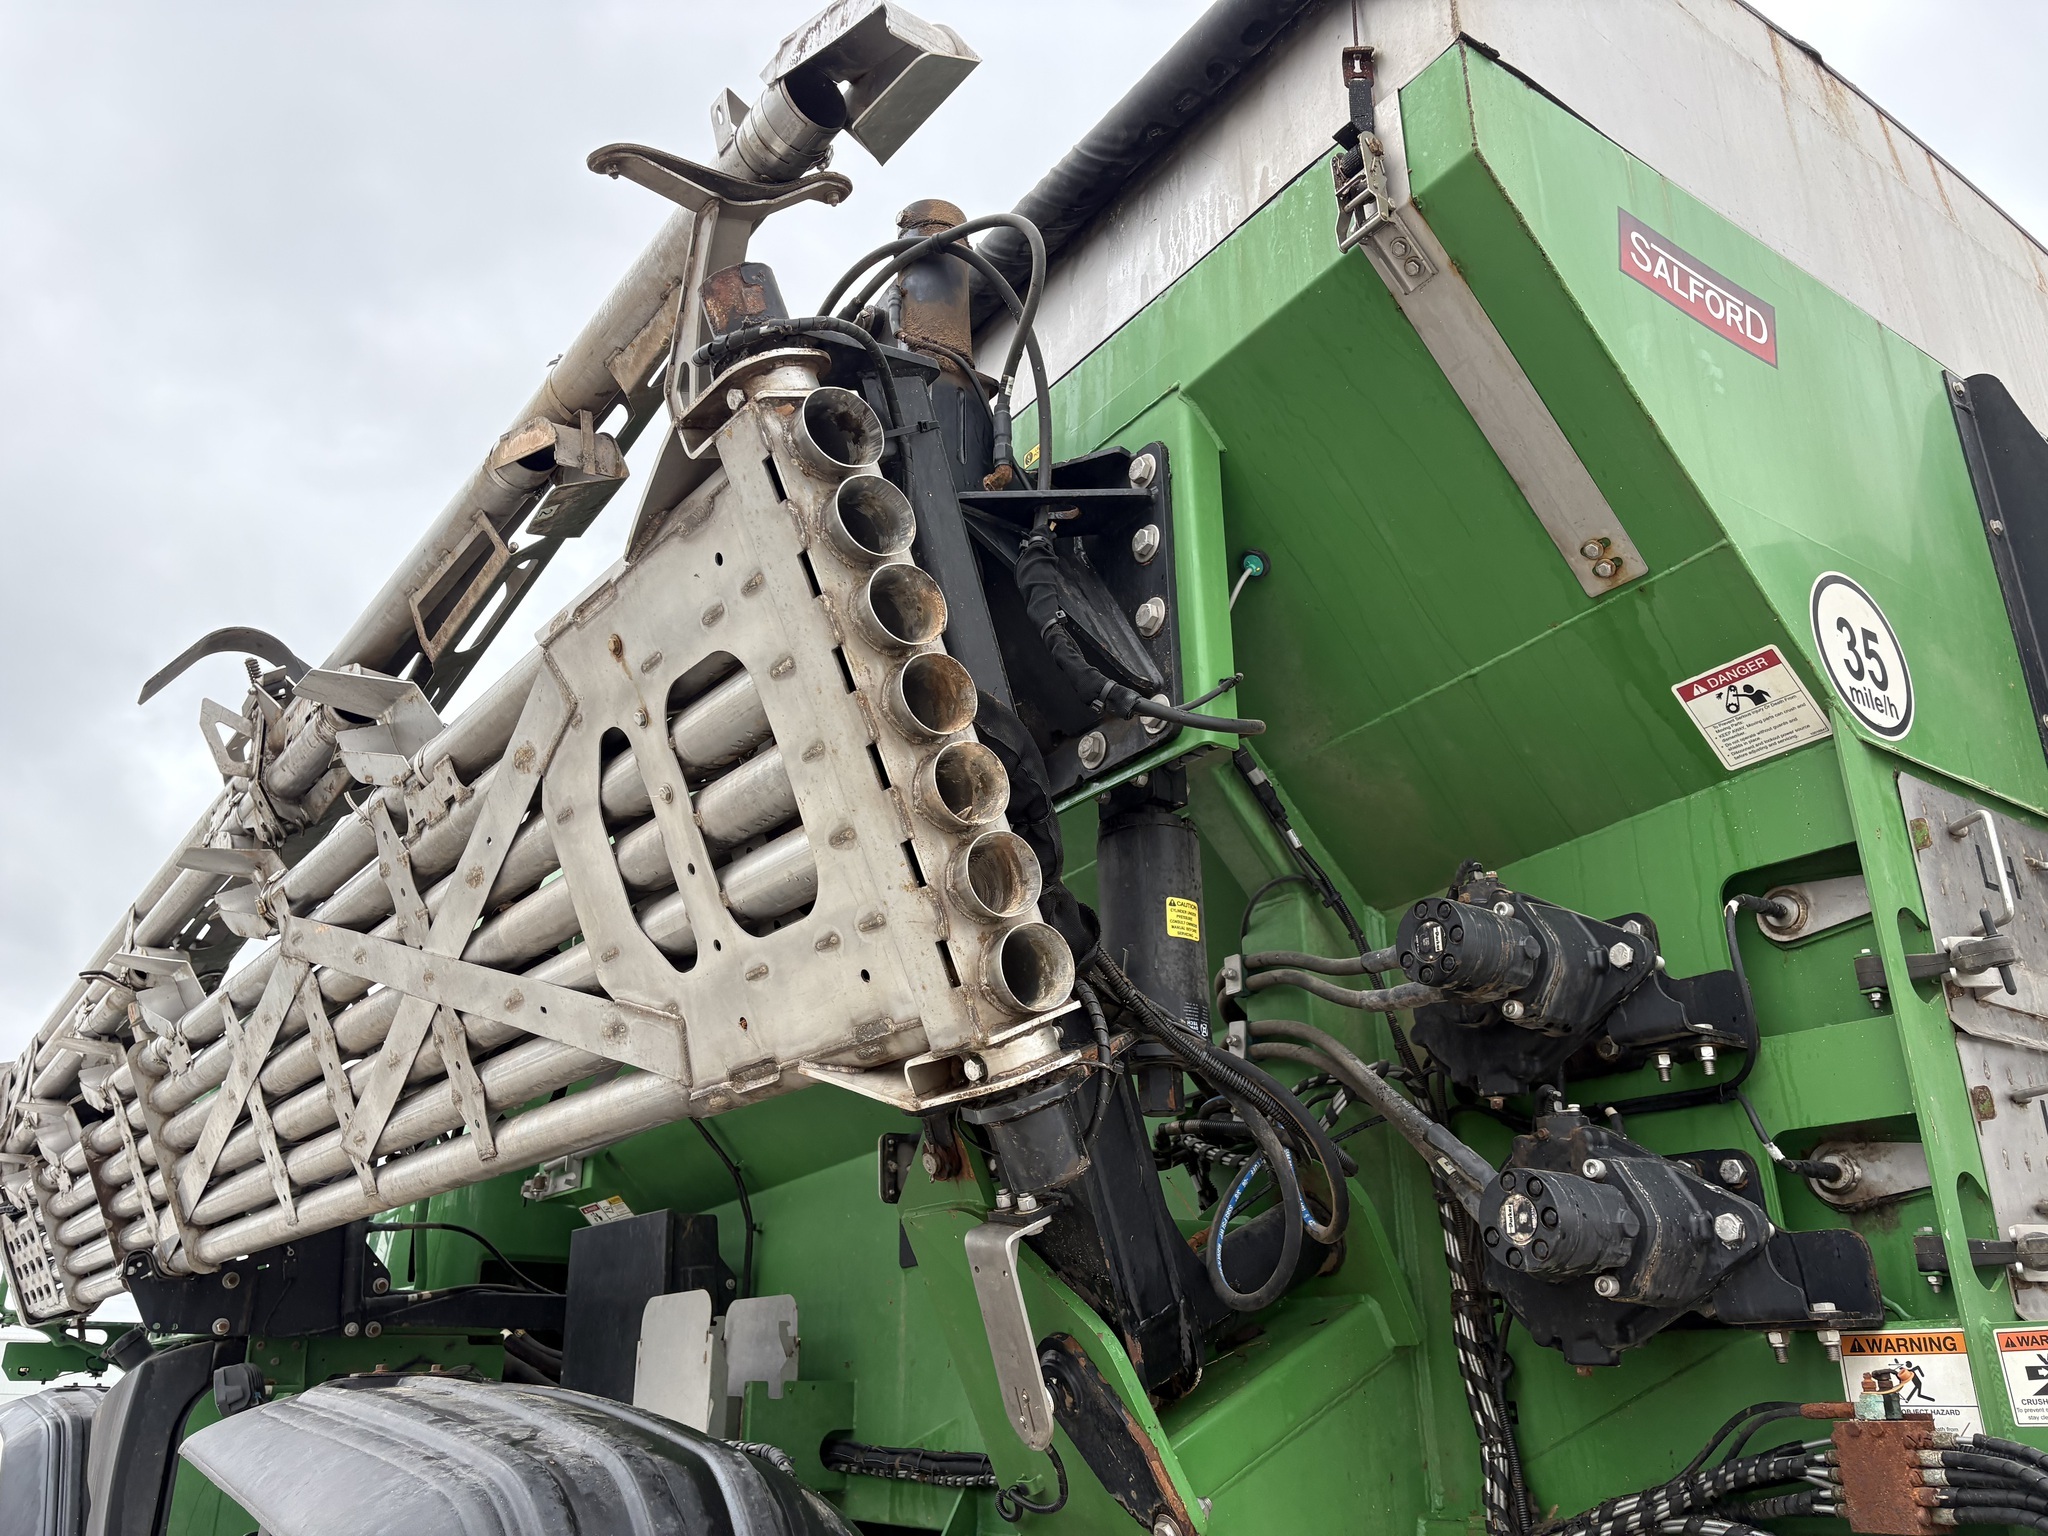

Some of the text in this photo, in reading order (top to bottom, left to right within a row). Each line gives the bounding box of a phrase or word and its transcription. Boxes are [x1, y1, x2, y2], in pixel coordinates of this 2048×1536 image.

[1630, 231, 1768, 345] SALFORD
[1836, 616, 1889, 692] 35
[1706, 657, 1769, 688] DANGER
[1718, 719, 1735, 727] Prevent
[1770, 699, 1784, 707] Death
[1849, 685, 1900, 720] mile/h
[1740, 733, 1756, 742] operate
[1757, 727, 1772, 735] without
[1773, 721, 1788, 730] guards
[1746, 719, 1763, 728] Moving
[1731, 745, 1755, 756] Disconnect
[1764, 735, 1780, 743] lockout
[1780, 730, 1794, 738] power
[1795, 724, 1810, 732] source
[1734, 752, 1748, 760] before
[1749, 745, 1768, 754] adjusting
[1177, 901, 1197, 910] CAUTION
[1865, 1336, 1957, 1353] WARNING
[2016, 1335, 2048, 1347] WAR
